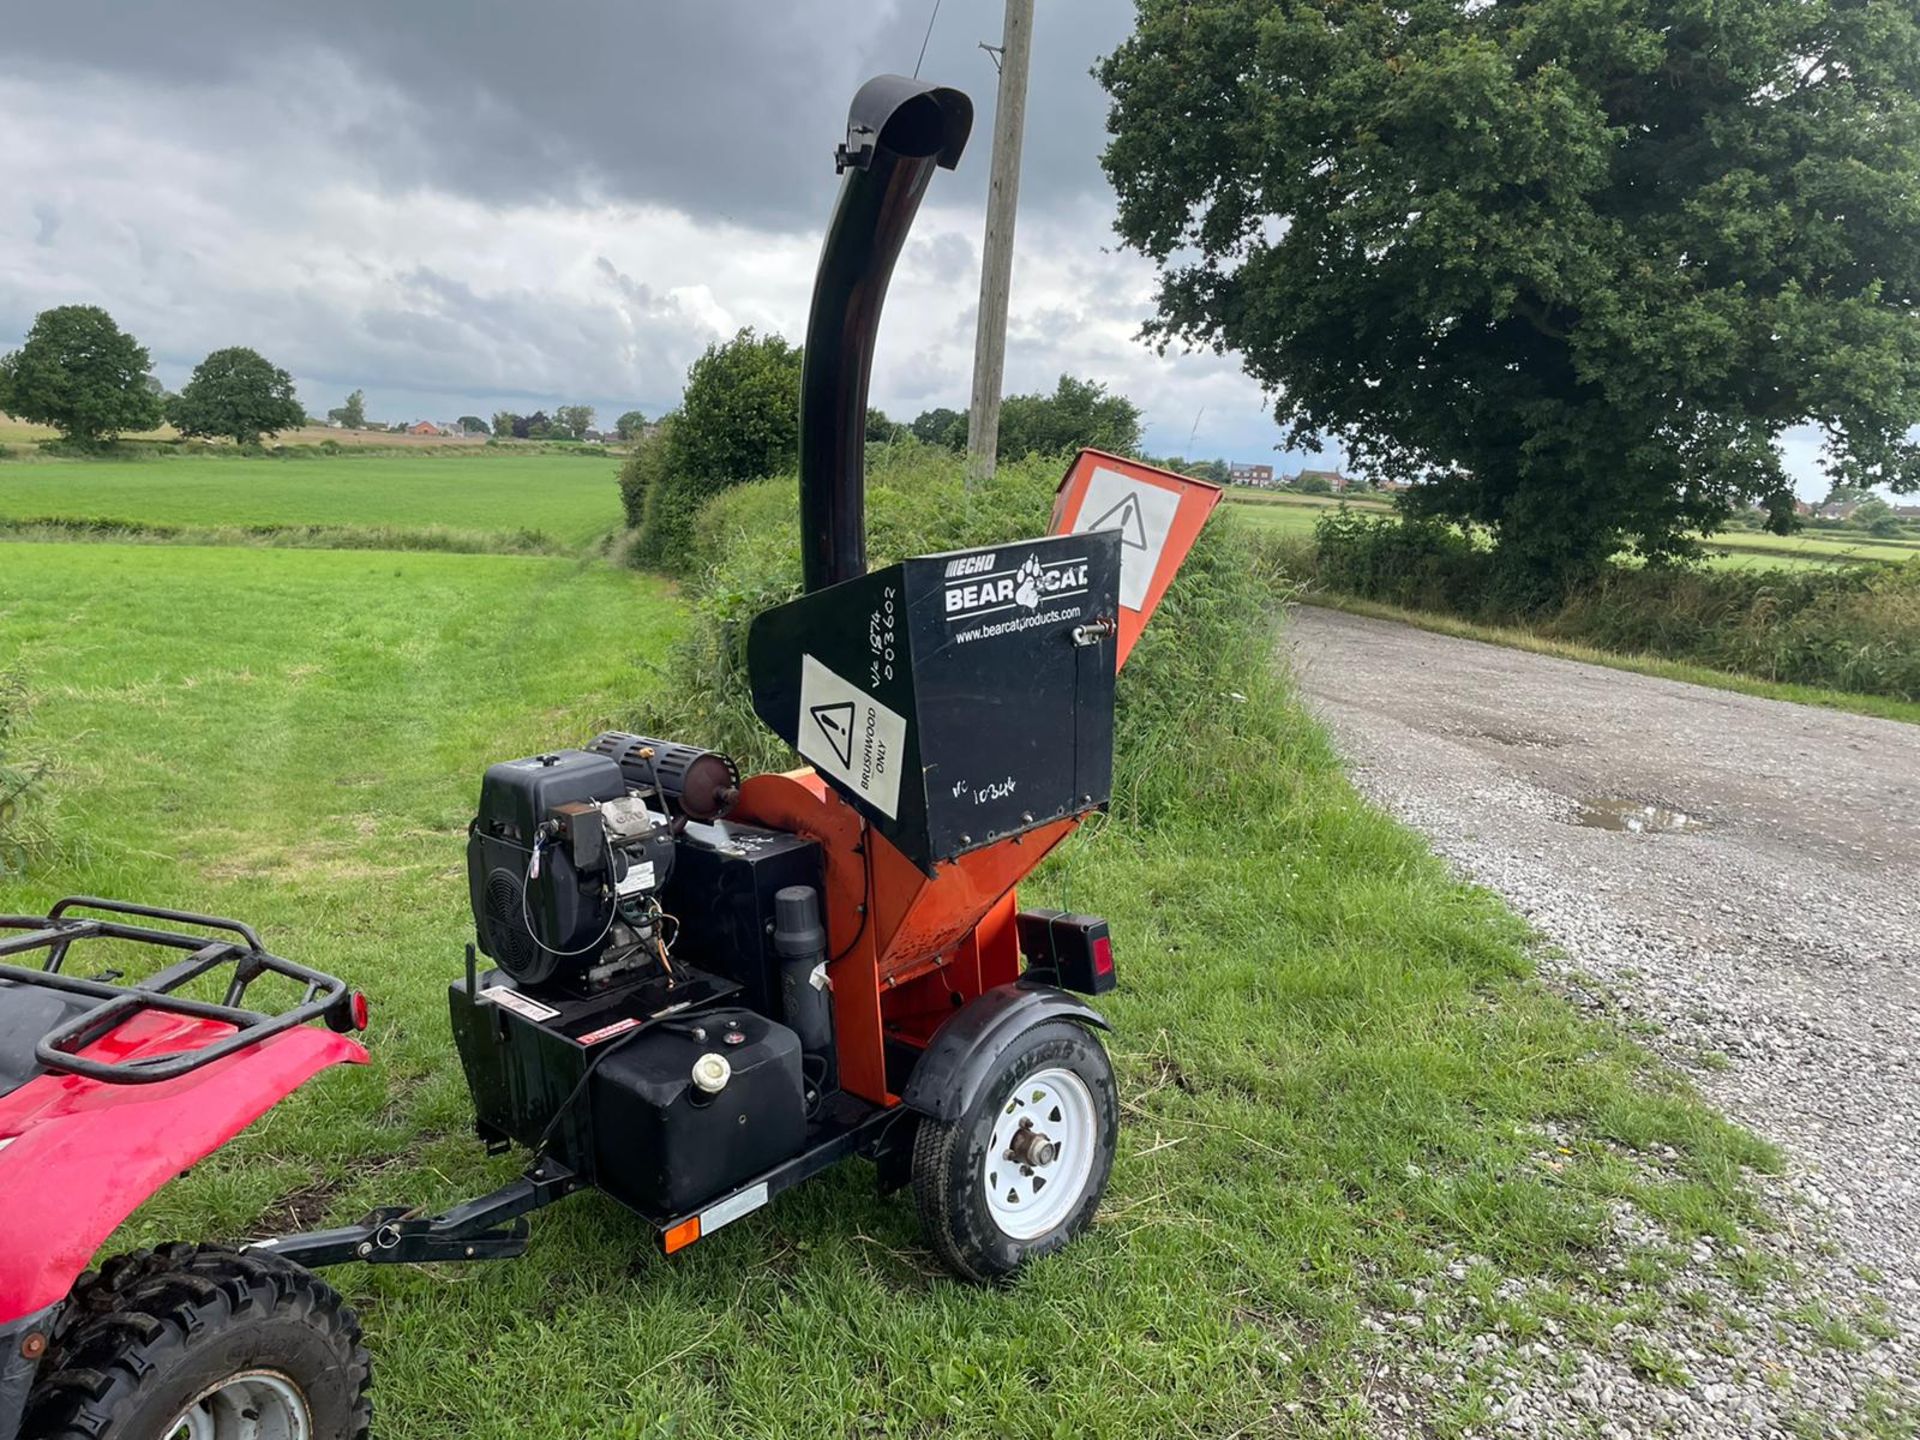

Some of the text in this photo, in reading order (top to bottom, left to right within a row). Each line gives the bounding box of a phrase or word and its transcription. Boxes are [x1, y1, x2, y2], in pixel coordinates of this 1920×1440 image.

[950, 553, 996, 577] ECHO
[945, 579, 1014, 612] BEAR
[882, 586, 896, 681] 003602
[955, 606, 1081, 644] www.bearcatproducts.com
[860, 707, 876, 790] BRUSHWOOD
[875, 740, 887, 774] ONLY
